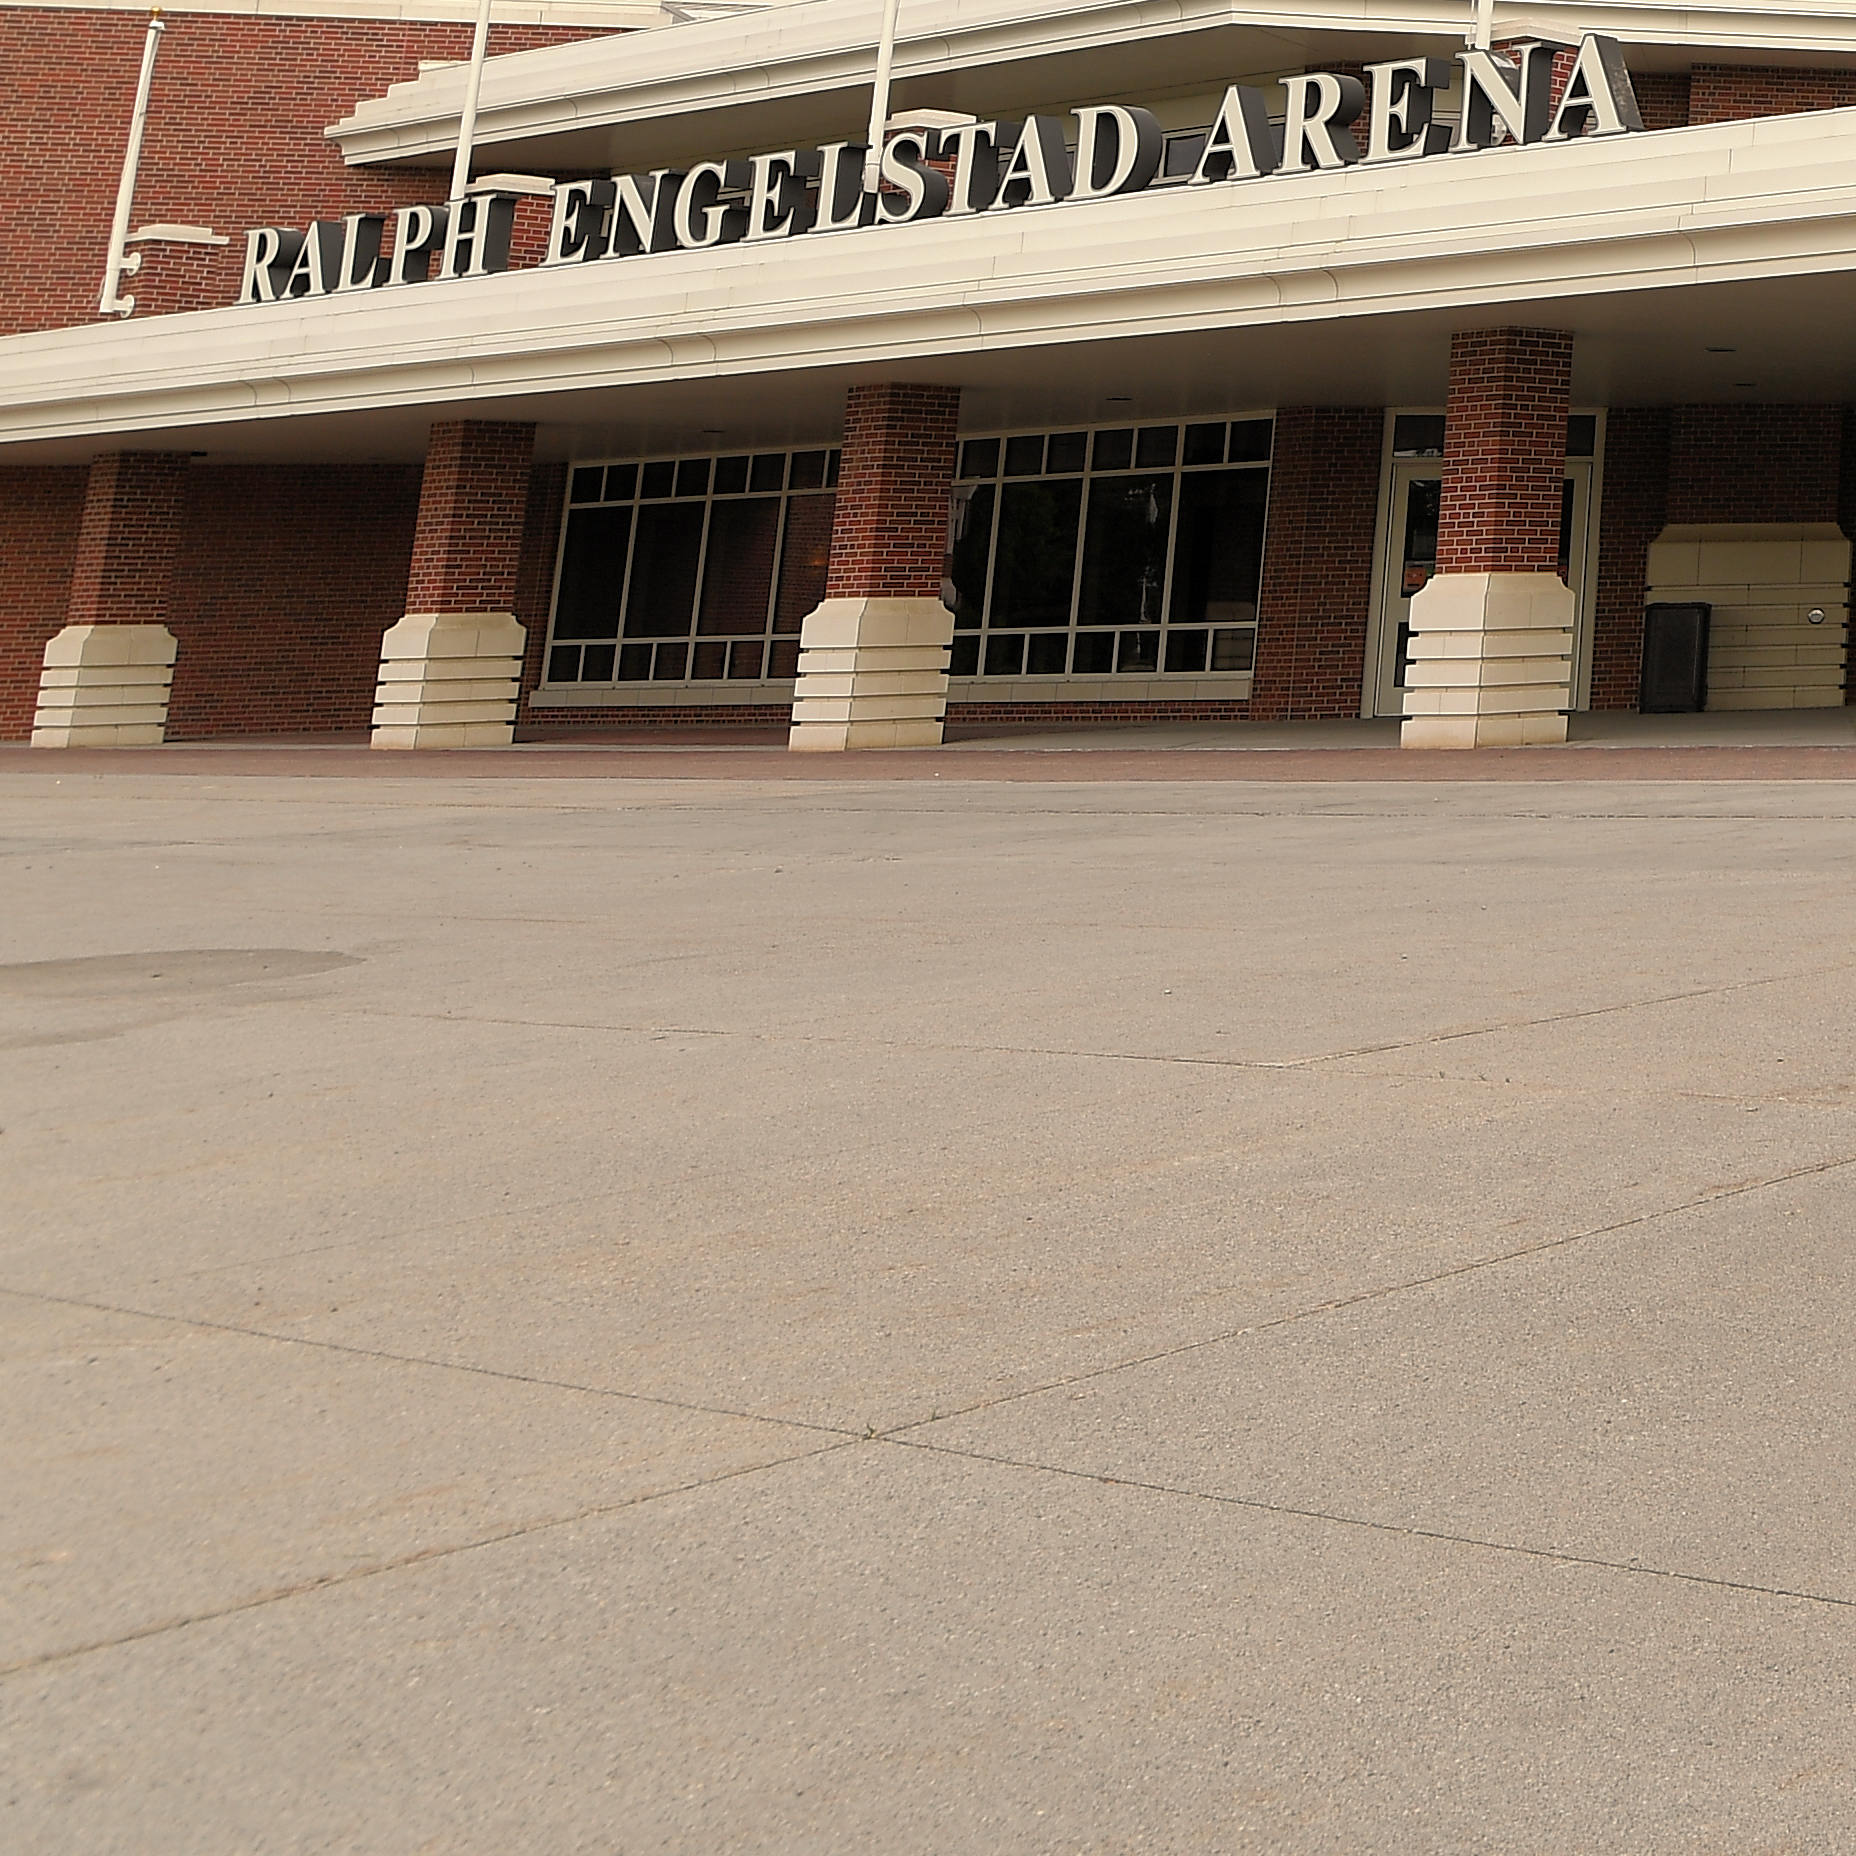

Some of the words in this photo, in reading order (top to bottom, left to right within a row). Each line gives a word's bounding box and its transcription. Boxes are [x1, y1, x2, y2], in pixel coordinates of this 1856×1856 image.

[235, 194, 500, 305] RALPH
[539, 105, 1143, 268] ENGELSTAD
[1188, 33, 1628, 185] ARENA
